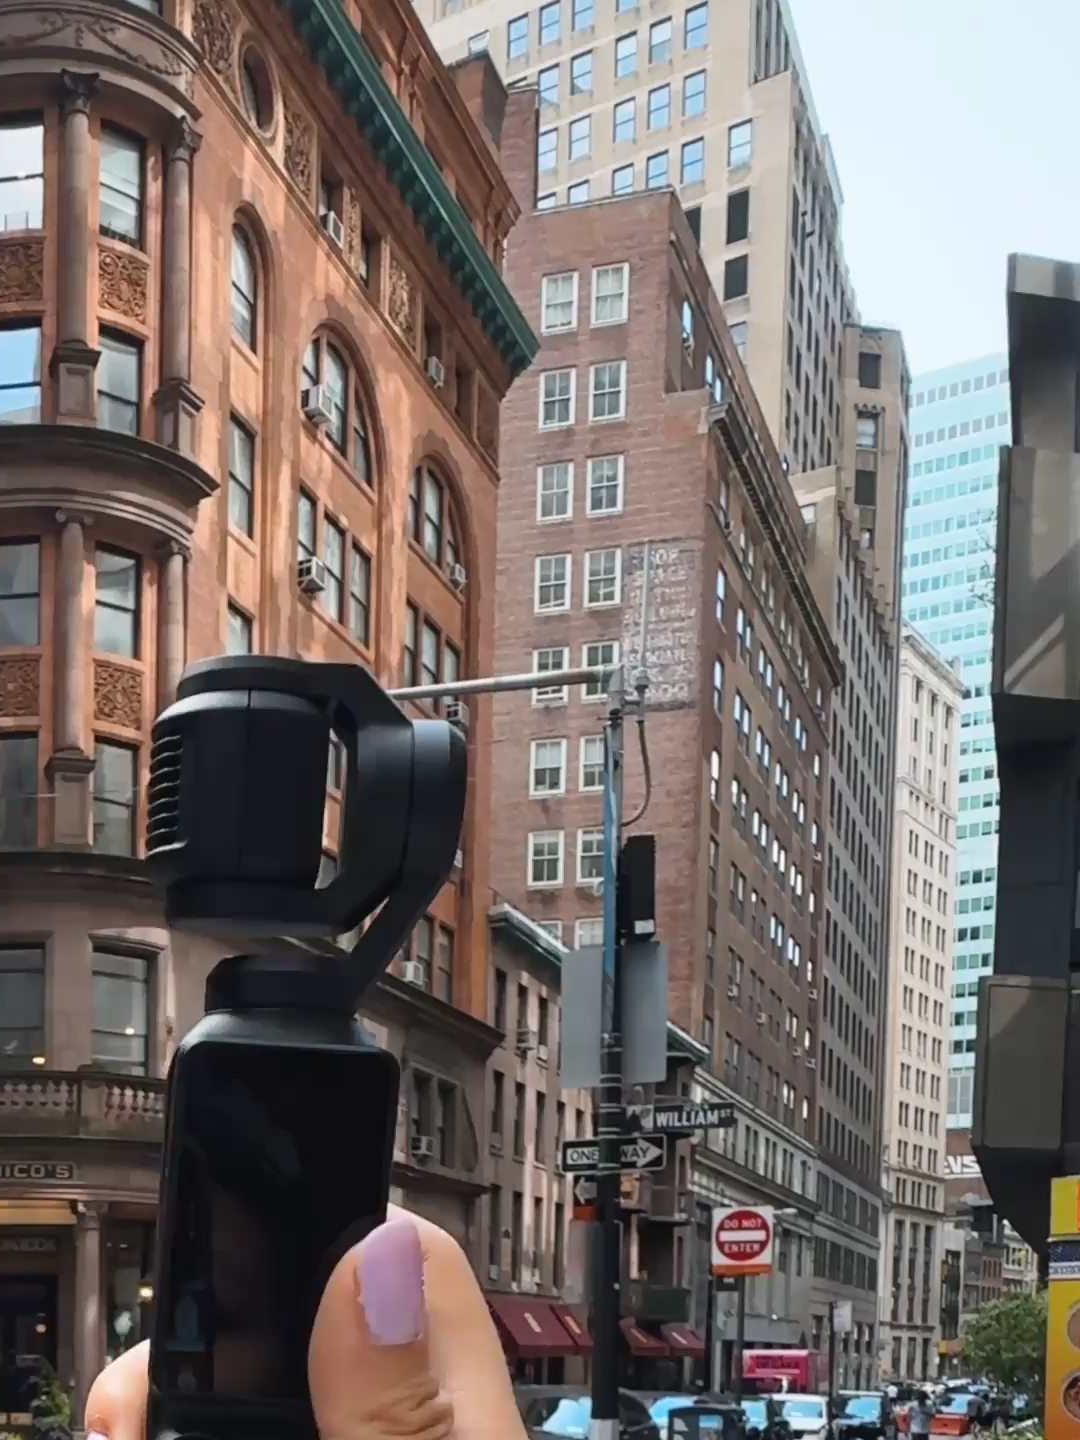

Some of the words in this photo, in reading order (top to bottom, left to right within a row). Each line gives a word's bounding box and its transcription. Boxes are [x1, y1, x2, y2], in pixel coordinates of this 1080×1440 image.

[656, 1110, 719, 1127] WILLIAM
[570, 1149, 599, 1163] ONE
[724, 1219, 739, 1229] DO
[741, 1218, 762, 1228] NOT
[723, 1243, 760, 1253] ENTER
